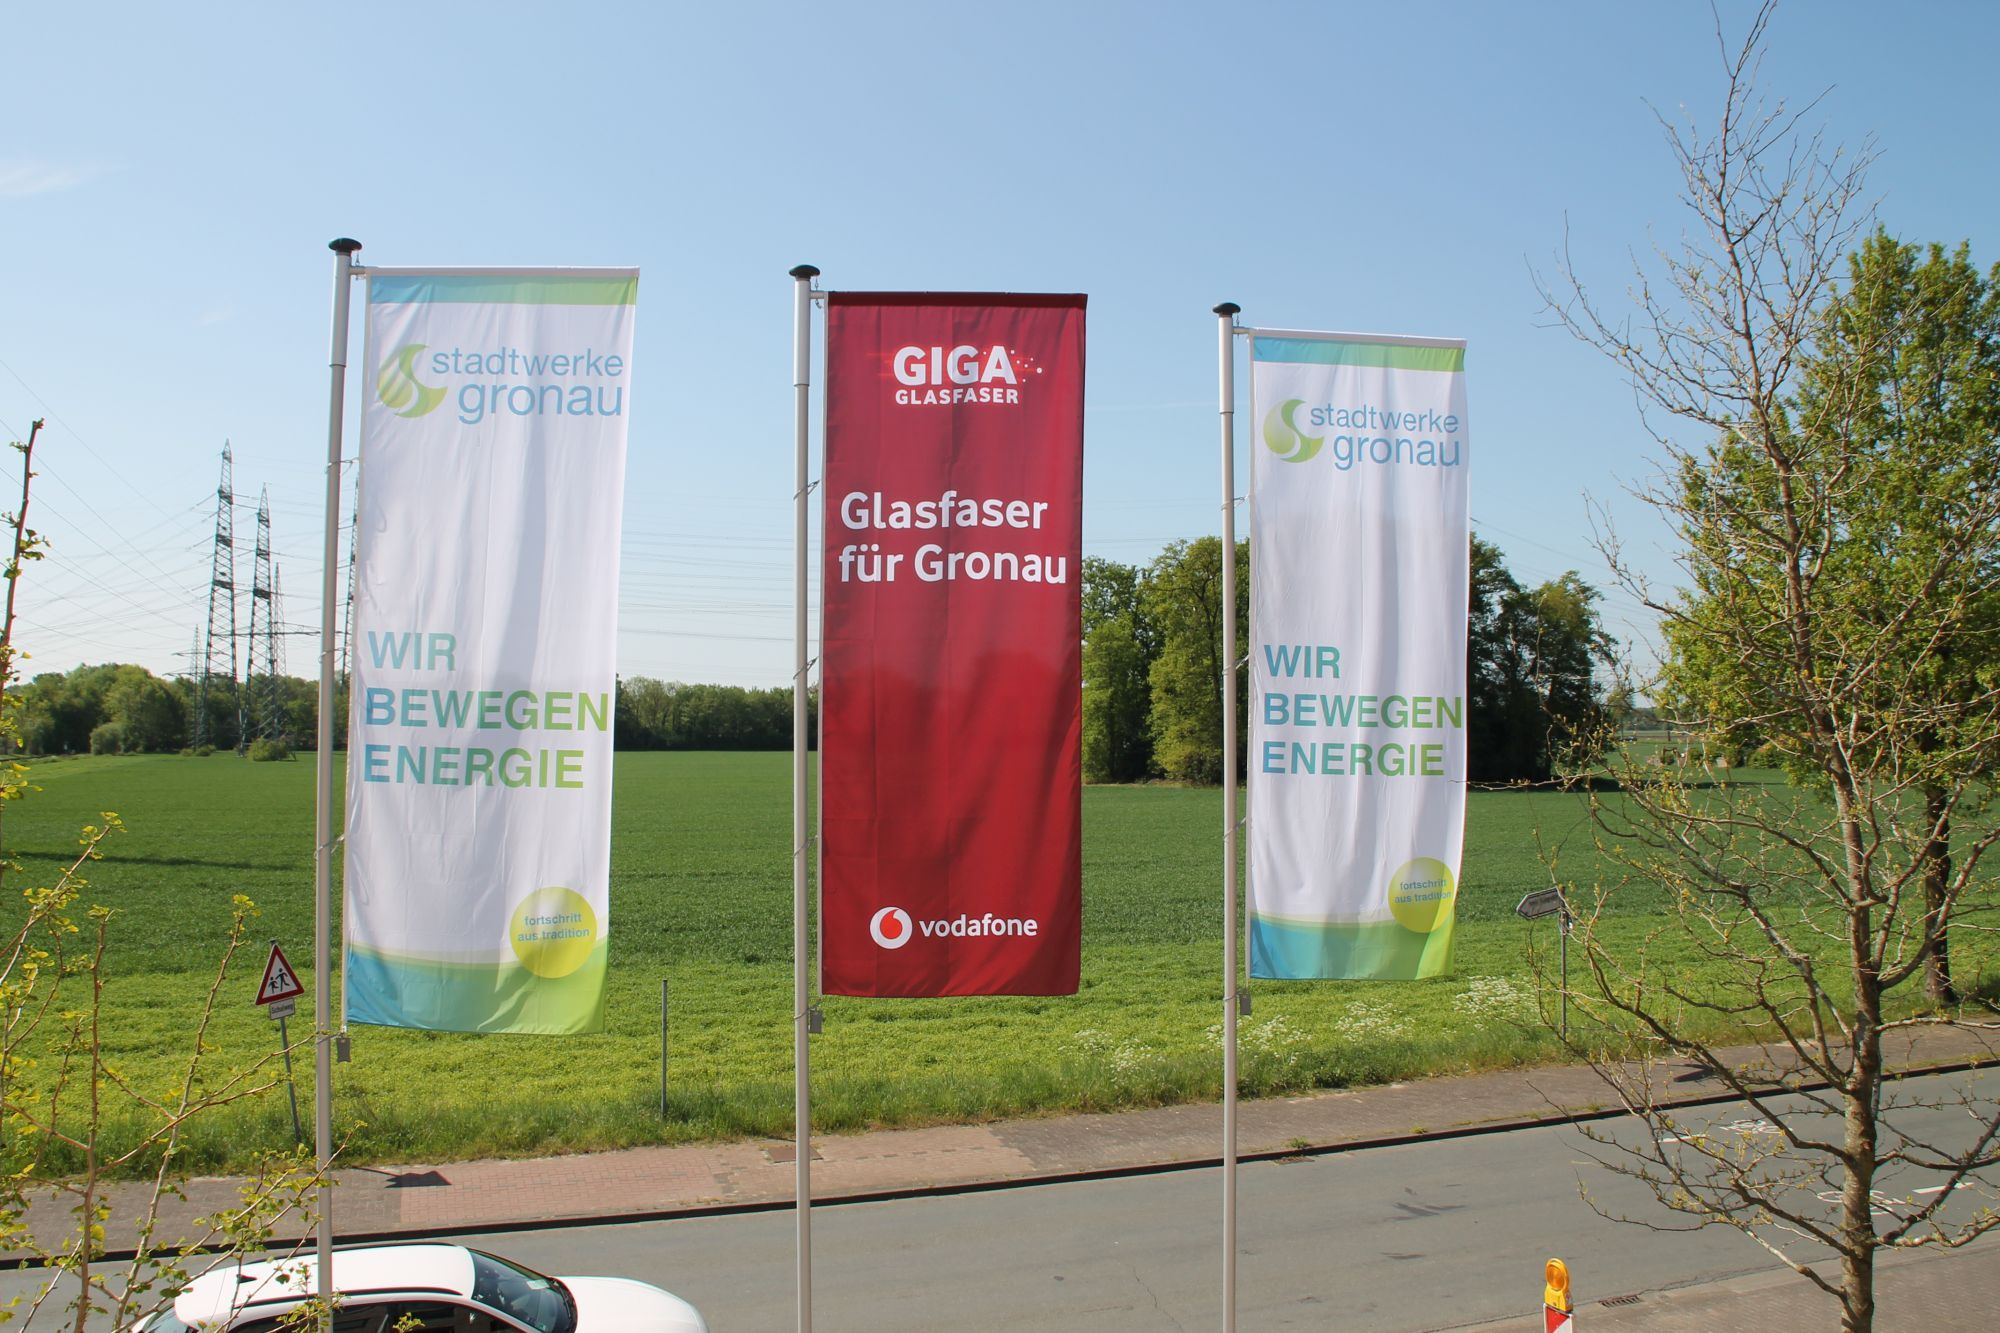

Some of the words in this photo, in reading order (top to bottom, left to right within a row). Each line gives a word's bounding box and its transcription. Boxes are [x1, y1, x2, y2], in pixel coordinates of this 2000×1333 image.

[432, 346, 624, 377] stadtwerke
[893, 345, 1017, 386] GIGA
[458, 383, 623, 425] gronau
[895, 387, 1019, 405] GLASFASER
[1310, 403, 1459, 434] stadtwerke
[1333, 434, 1460, 471] gronau
[841, 490, 1048, 530] Glasfaser
[839, 544, 904, 582] für
[914, 544, 1067, 584] Gronau
[367, 630, 457, 671] WIR
[1264, 644, 1341, 678] WIR
[365, 687, 609, 731] BEWEGEN
[1263, 692, 1462, 729] BEWEGEN
[363, 743, 585, 788] ENERGIE
[1262, 741, 1445, 776] ENERGIE
[1394, 895, 1412, 904] aus
[1415, 892, 1451, 902] tradition
[1400, 880, 1446, 890] fortschritt
[517, 932, 539, 942] aus
[542, 928, 590, 940] tradition
[524, 913, 582, 925] fortschritt
[919, 913, 1038, 937] vodafone
